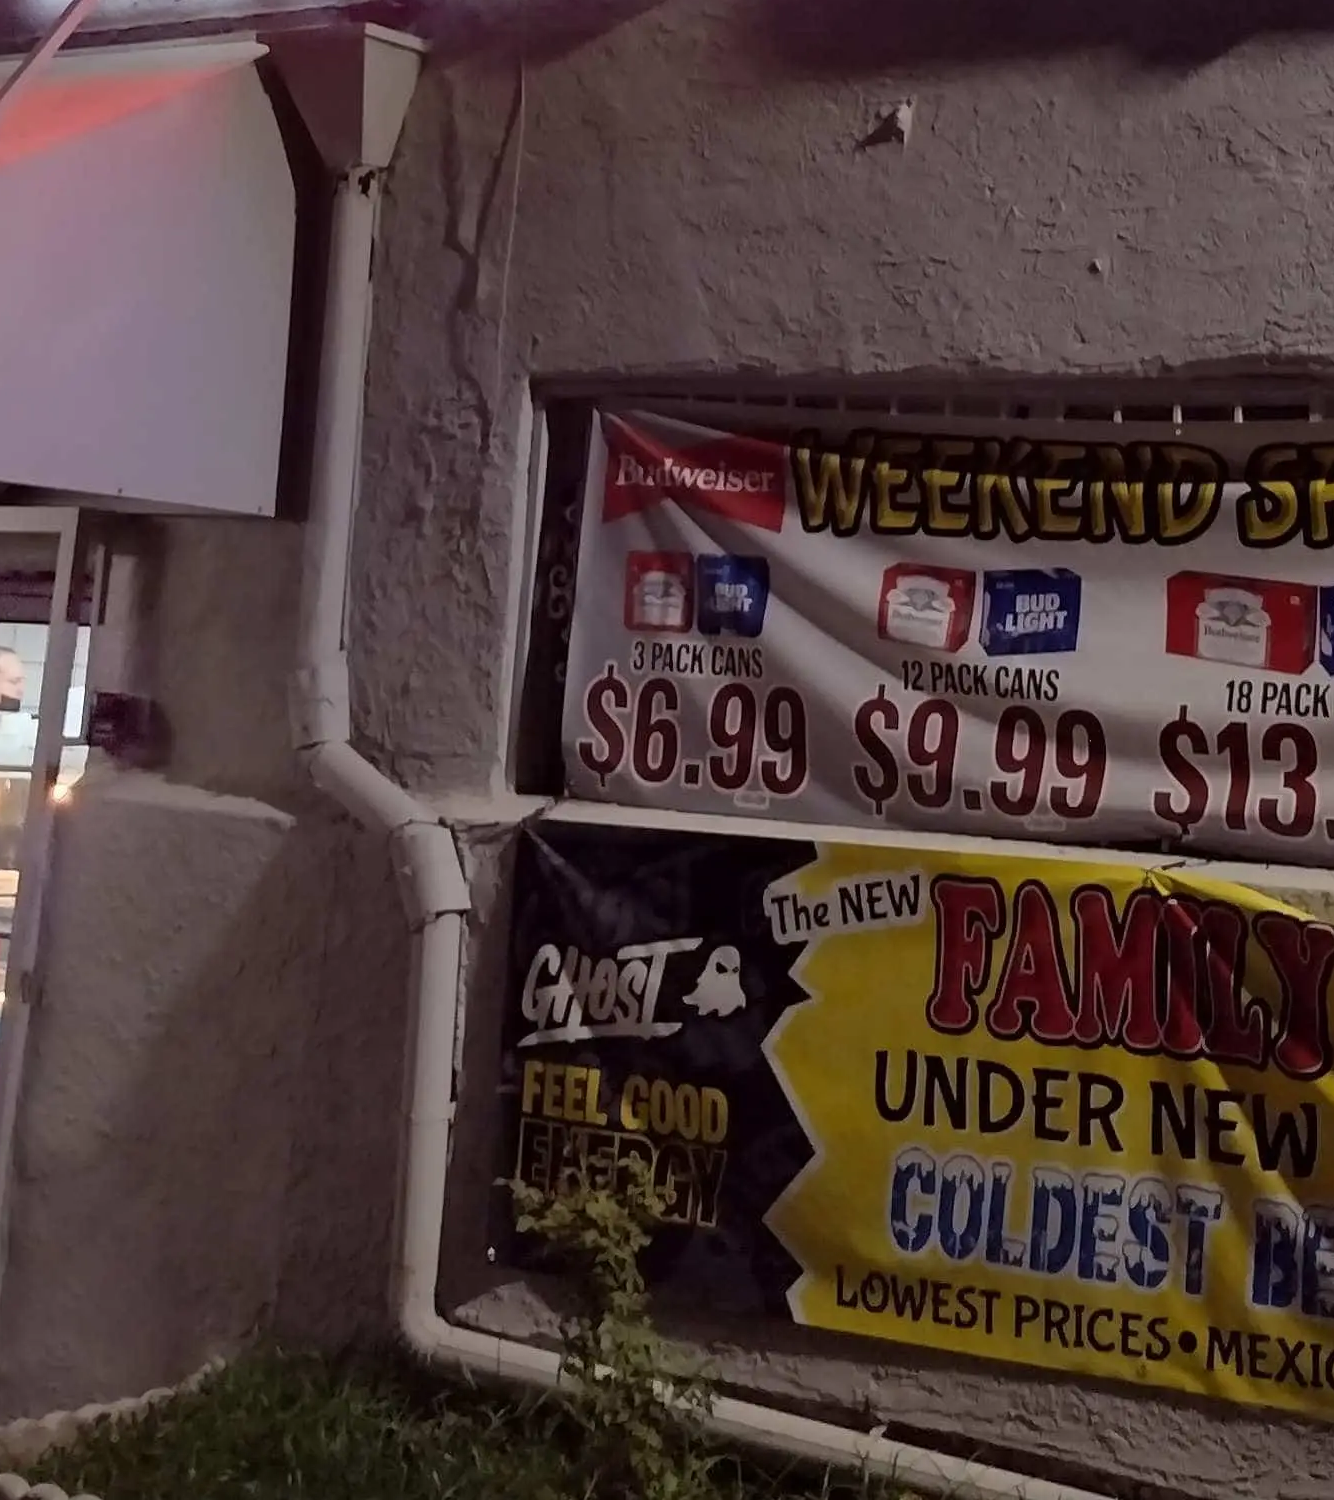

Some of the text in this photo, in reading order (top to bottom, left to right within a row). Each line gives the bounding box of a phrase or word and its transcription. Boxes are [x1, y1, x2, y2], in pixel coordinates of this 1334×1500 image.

[615, 452, 776, 493] Budweiser
[788, 428, 1228, 546] WEEKEND
[1005, 610, 1067, 635] LIGHT
[1016, 592, 1060, 613] BUD
[634, 641, 763, 678] 3 PACK CANS
[902, 660, 1060, 702] 12 PACK CANS
[1226, 680, 1253, 713] 18
[1260, 682, 1331, 718] PACK
[579, 664, 807, 795] $6.99
[854, 684, 1106, 819] $9.99
[771, 874, 920, 935] The NEW
[517, 936, 703, 1049] GHOST
[522, 1060, 730, 1145] FEEL GOOD
[874, 1049, 1124, 1152] UNDER
[1150, 1081, 1317, 1178] NEW
[889, 1146, 1223, 1295] COLDEST
[835, 1264, 1000, 1333] LOWEST
[1014, 1296, 1172, 1360] PRICES
